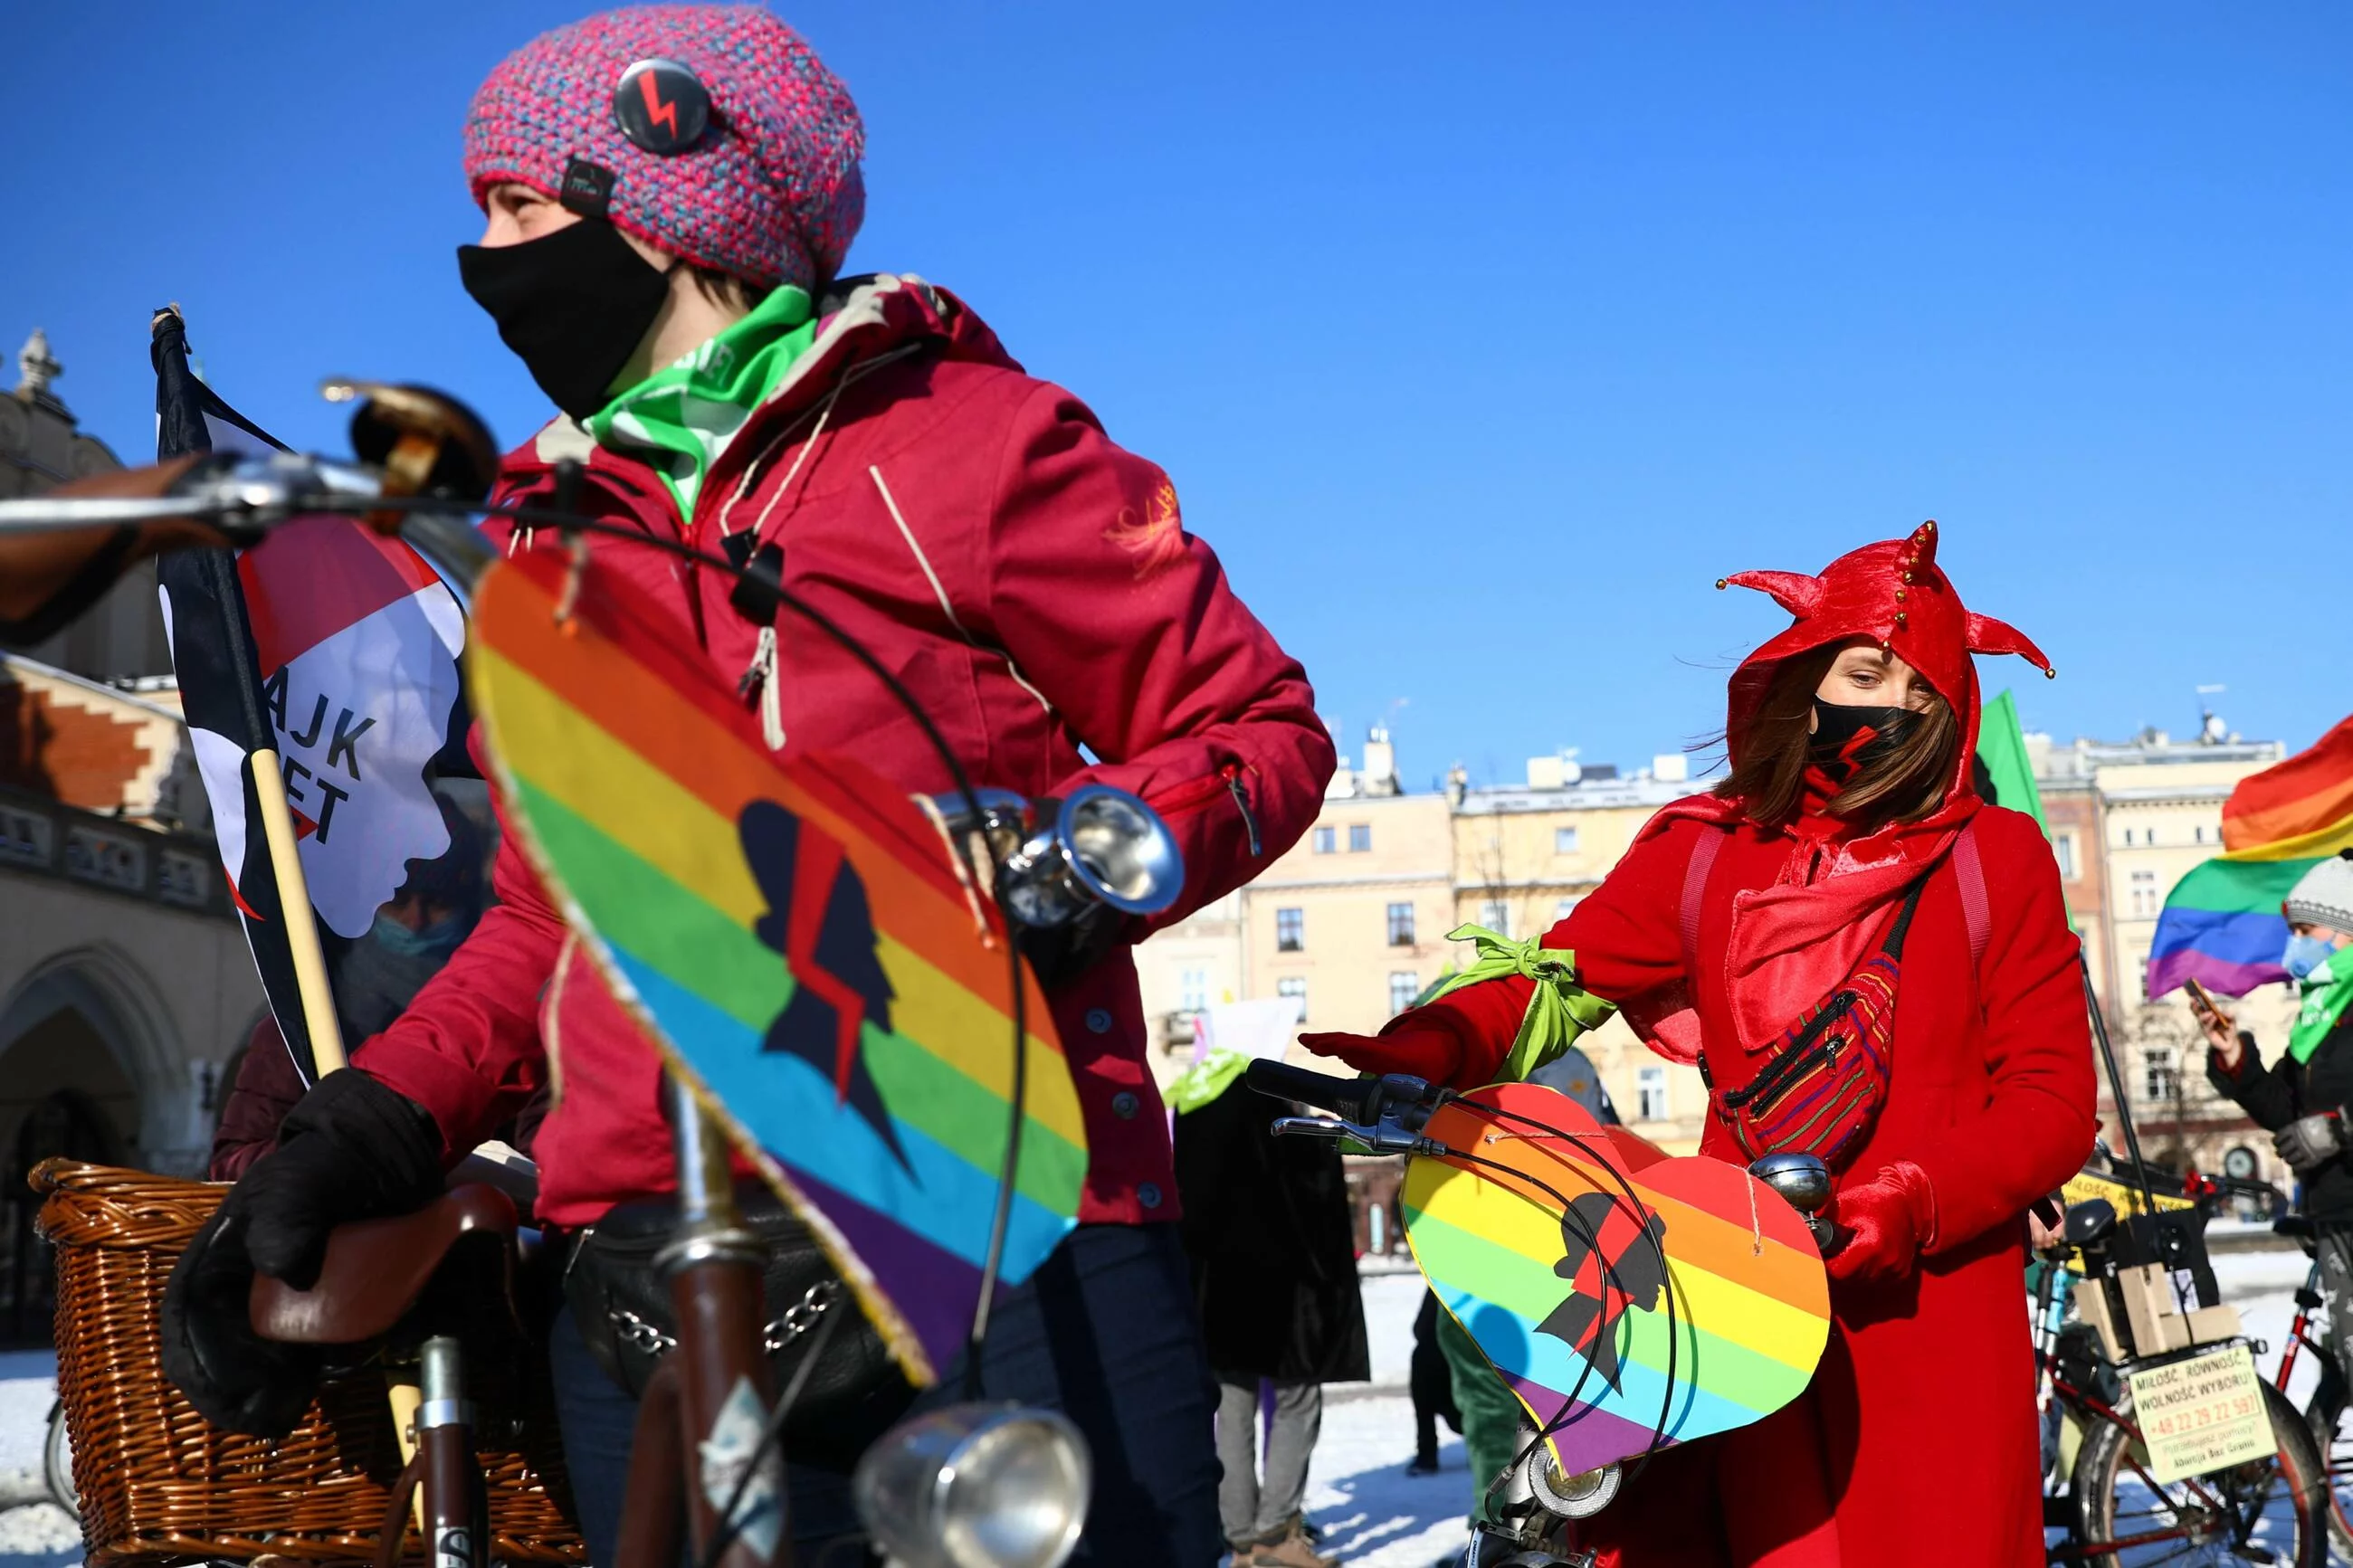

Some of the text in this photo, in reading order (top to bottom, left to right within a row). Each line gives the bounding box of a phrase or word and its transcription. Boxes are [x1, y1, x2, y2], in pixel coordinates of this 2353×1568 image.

[263, 665, 376, 782] AJK
[283, 755, 349, 845] ET
[2177, 1412, 2192, 1430] 22
[2215, 1402, 2230, 1421] 22
